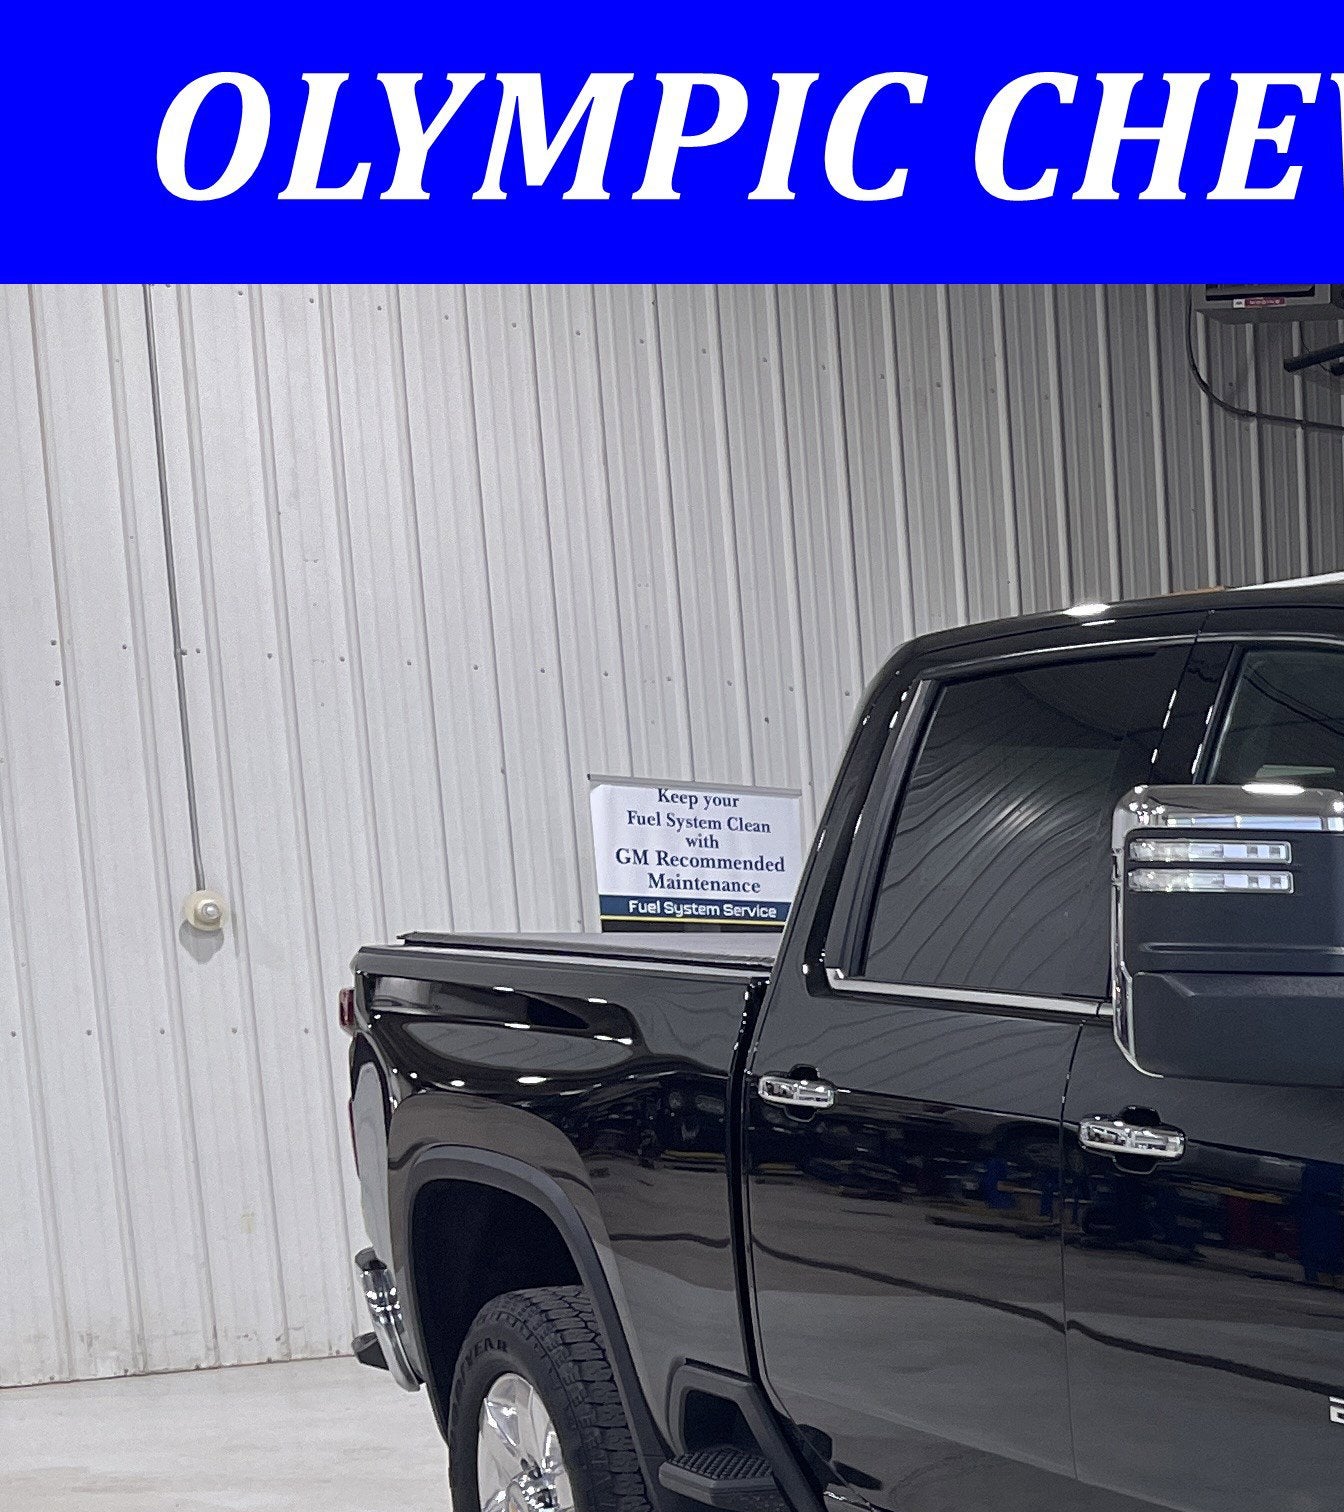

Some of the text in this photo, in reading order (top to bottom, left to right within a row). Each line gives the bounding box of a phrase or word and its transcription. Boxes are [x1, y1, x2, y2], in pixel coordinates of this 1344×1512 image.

[658, 788, 740, 810] Keep your
[627, 810, 771, 834] Fuel System Clean
[686, 834, 719, 849] with
[615, 848, 785, 872] GM Recommended
[647, 873, 761, 894] Maintenance
[629, 900, 777, 918] Fuel System Service
